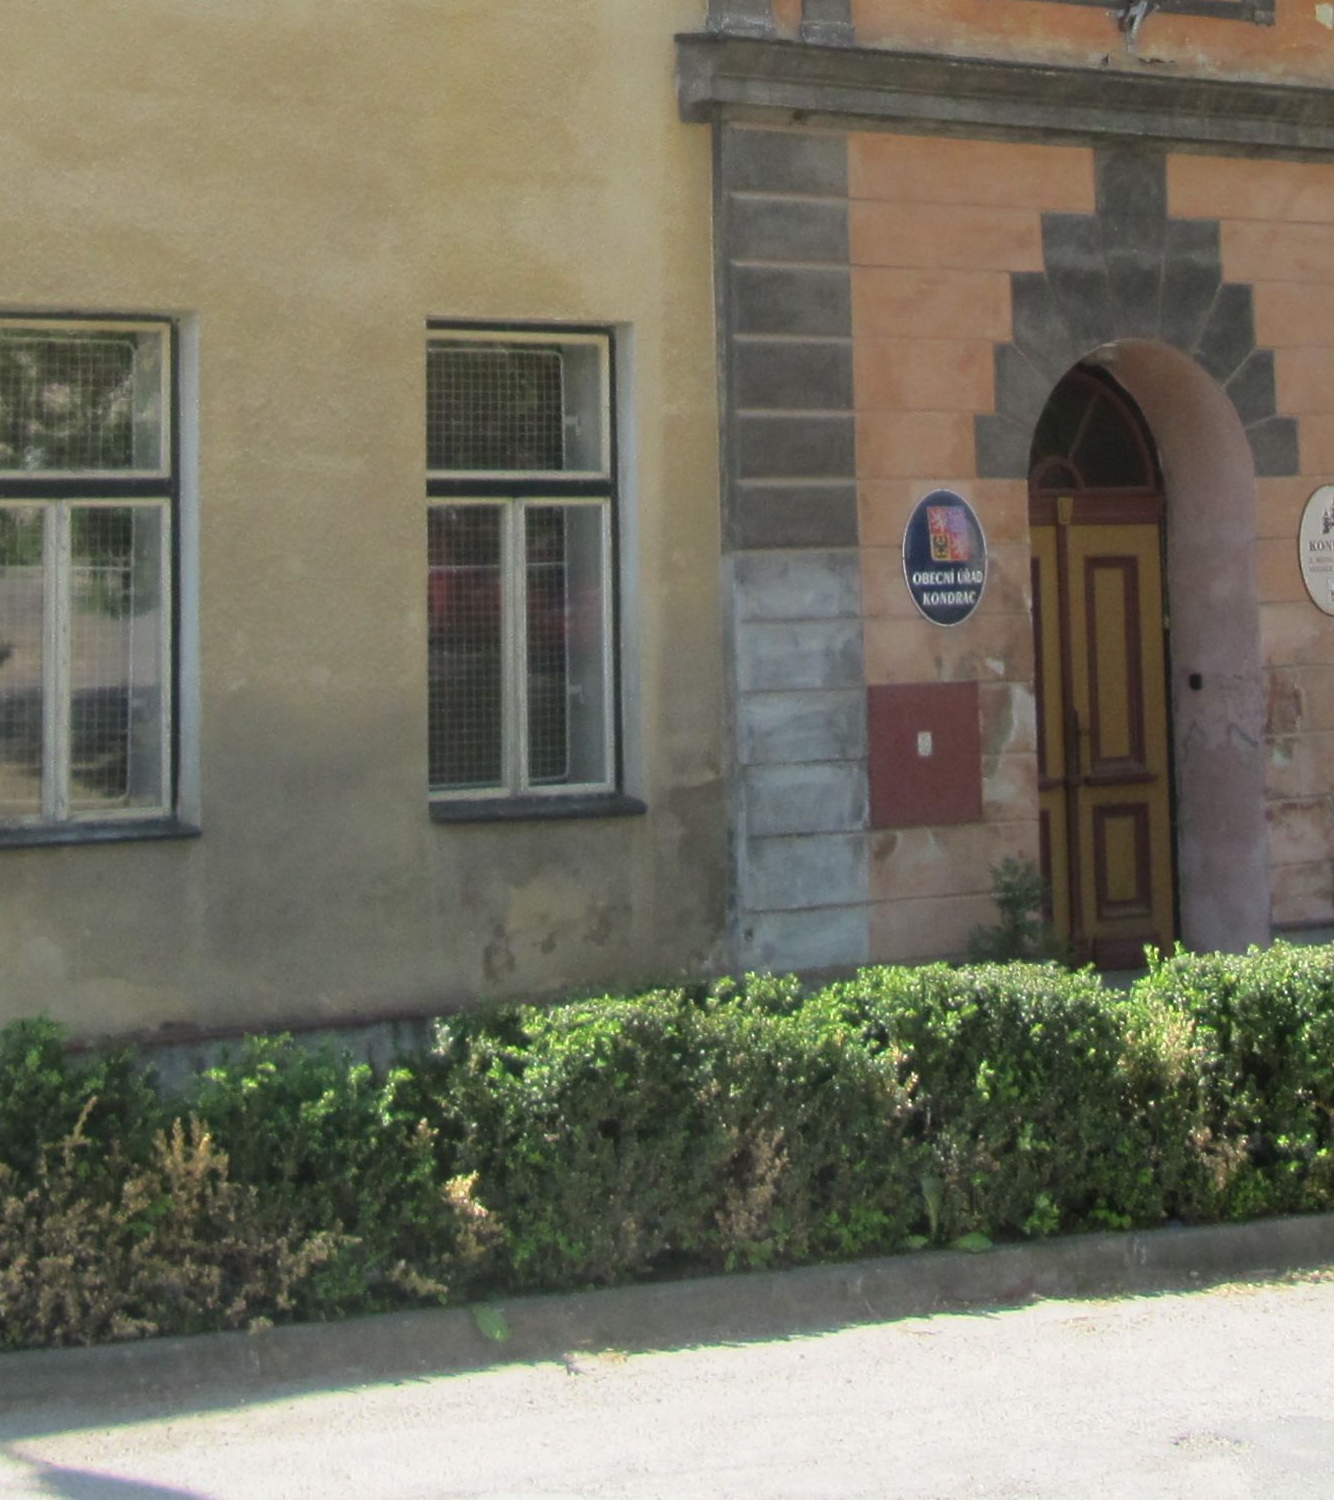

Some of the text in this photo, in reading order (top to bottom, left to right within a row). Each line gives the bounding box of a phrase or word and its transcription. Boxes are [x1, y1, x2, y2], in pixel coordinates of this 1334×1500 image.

[912, 568, 983, 585] OBECNÍ ÚŘAD
[922, 590, 976, 606] KONDRAC
